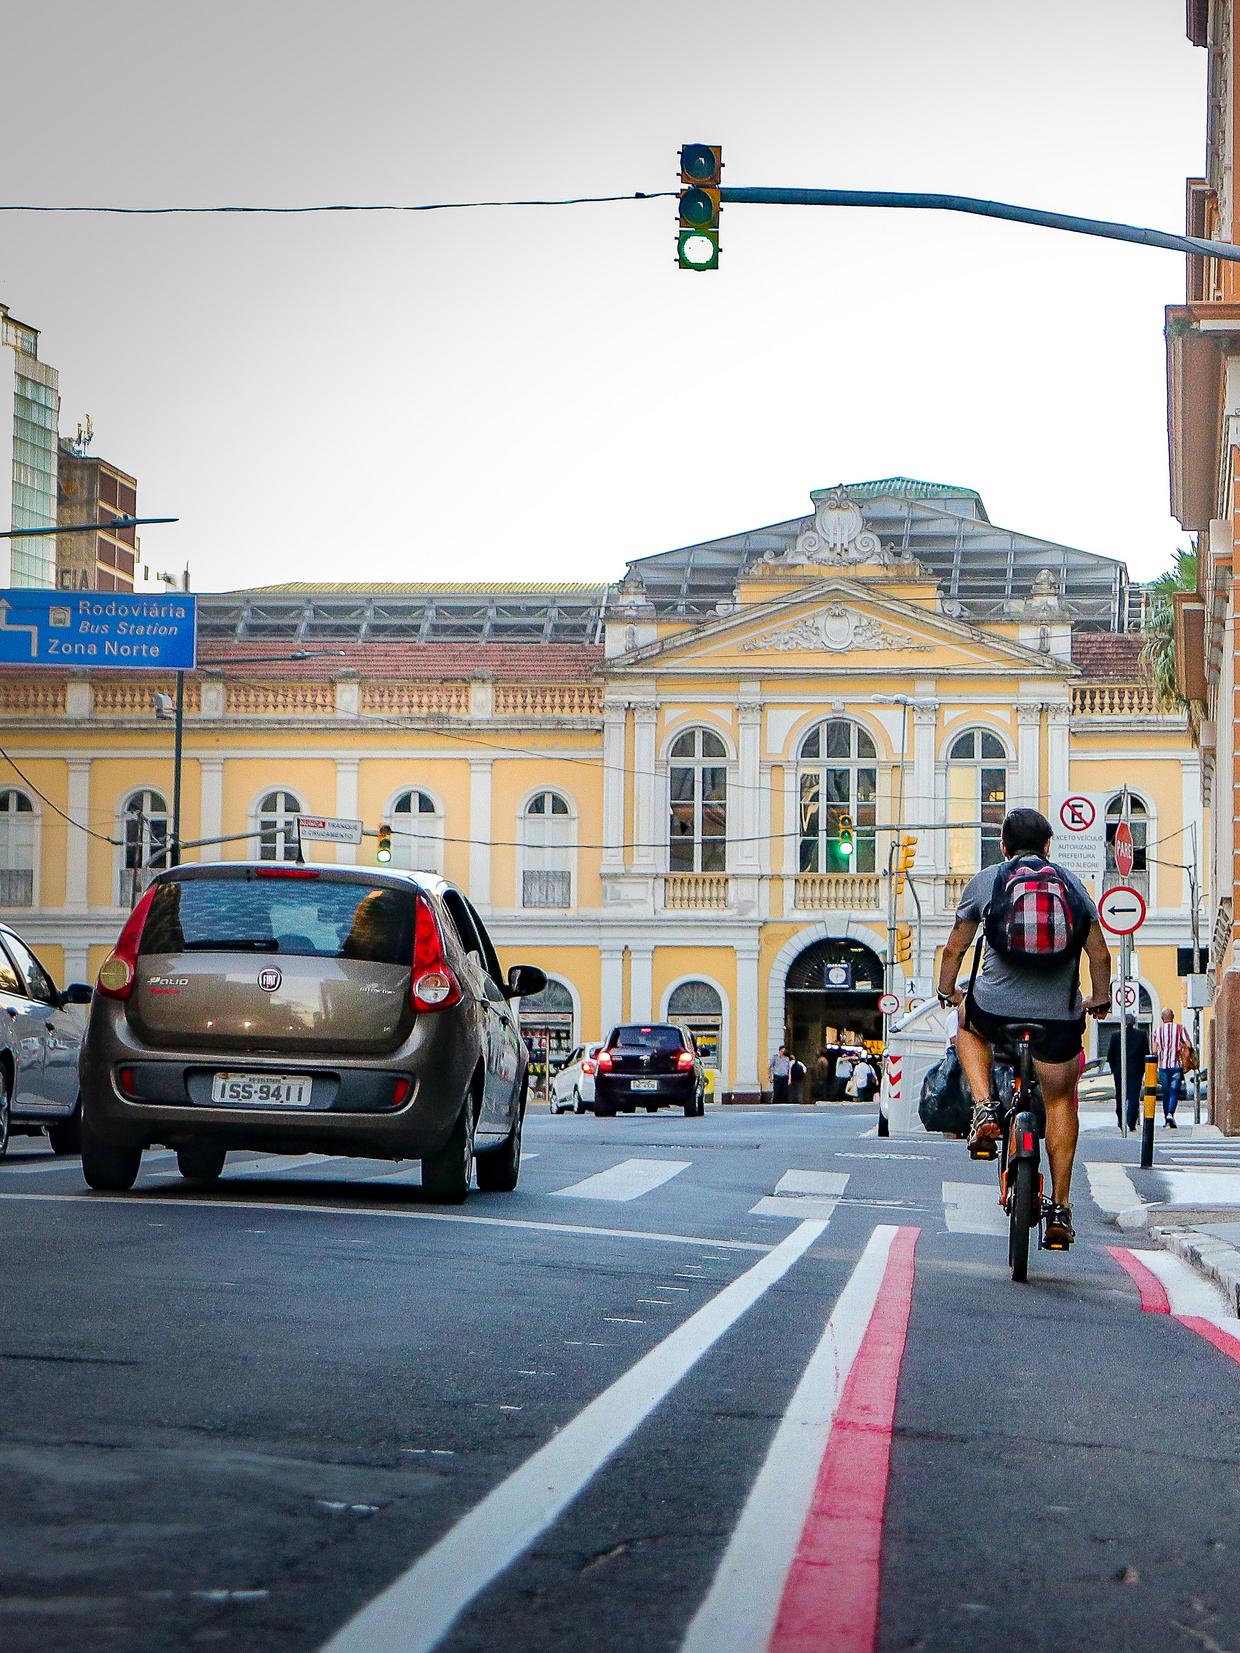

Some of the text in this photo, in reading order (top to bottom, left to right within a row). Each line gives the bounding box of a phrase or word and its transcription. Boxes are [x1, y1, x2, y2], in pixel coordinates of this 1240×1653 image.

[79, 600, 186, 618] Rodoviária
[79, 621, 178, 636] Bus Station
[48, 639, 161, 657] Zona Norte
[1117, 840, 1132, 859] PARE
[263, 974, 277, 986] FIAT
